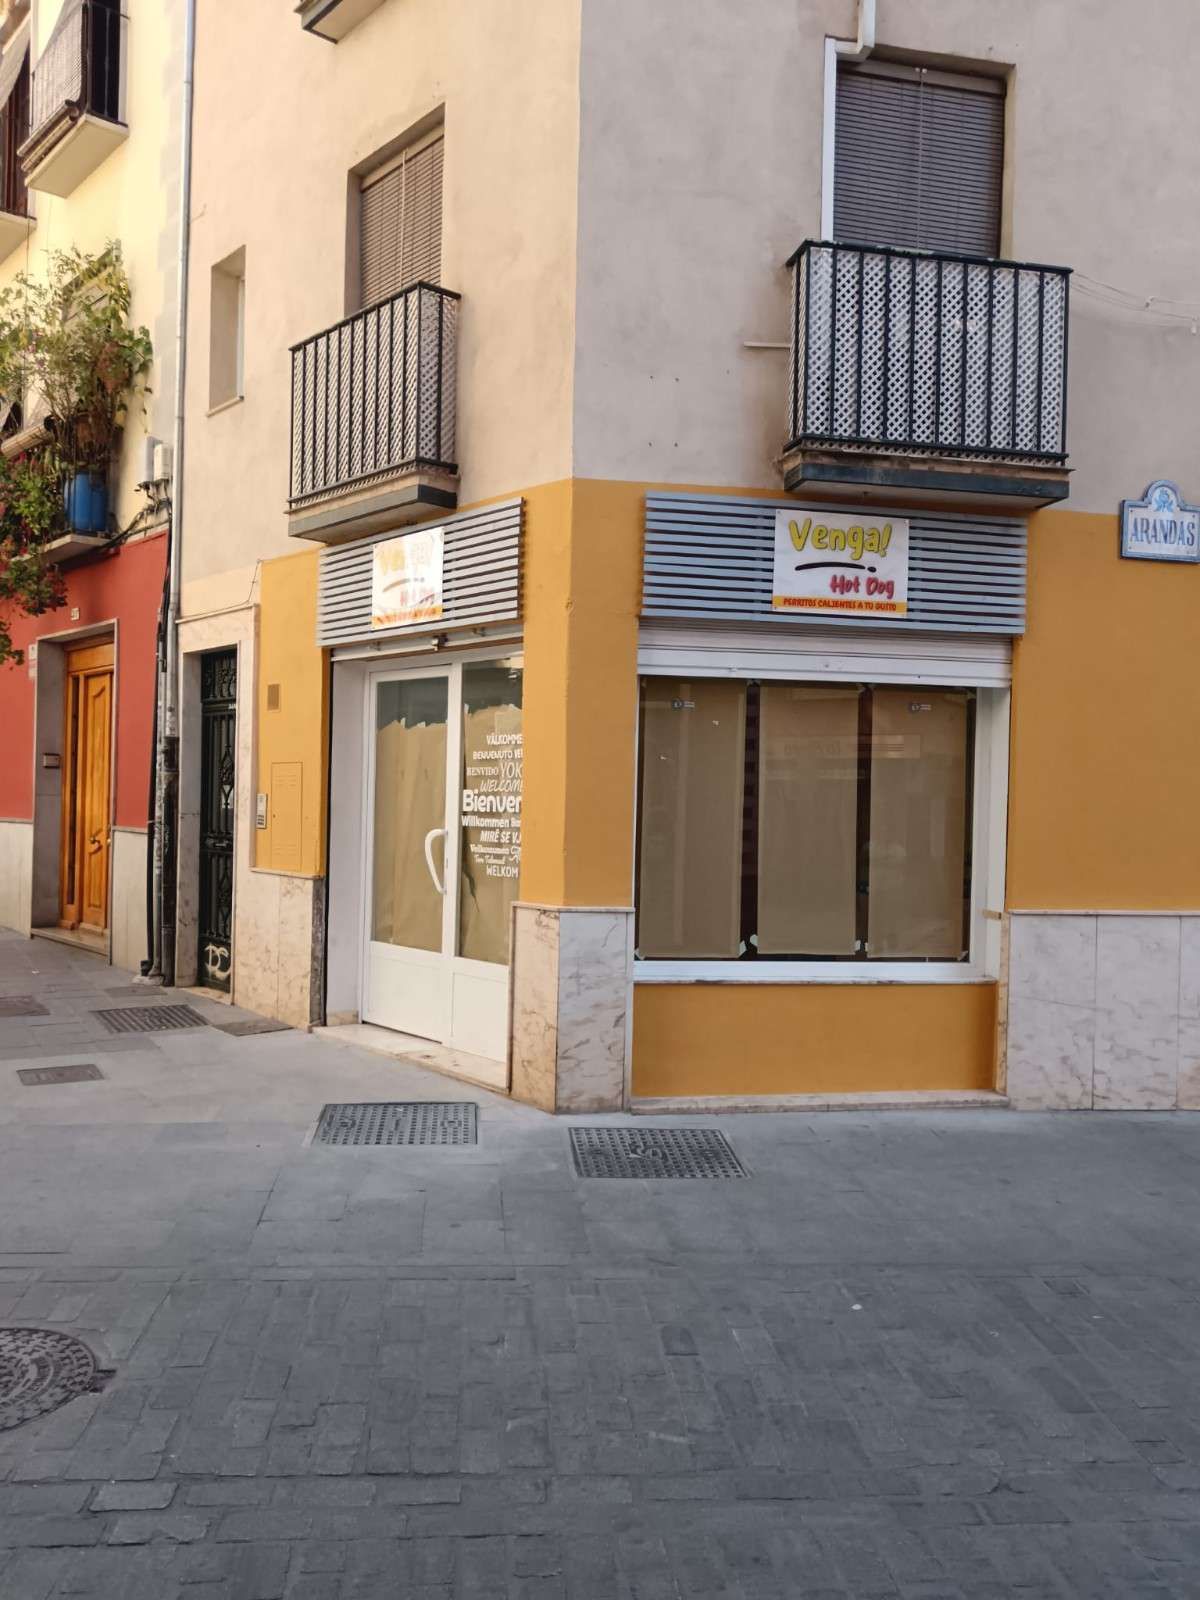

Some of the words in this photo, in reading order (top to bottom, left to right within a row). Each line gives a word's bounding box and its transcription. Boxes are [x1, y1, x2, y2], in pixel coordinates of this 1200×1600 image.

[788, 518, 892, 560] Venga!
[1130, 517, 1195, 546] ARANDAS
[830, 574, 861, 595] Hot
[866, 576, 895, 600] Dog
[783, 598, 816, 607] PERRITOS
[817, 599, 857, 609] CALIENTES
[857, 601, 863, 609] A
[462, 815, 510, 828] Willkommen
